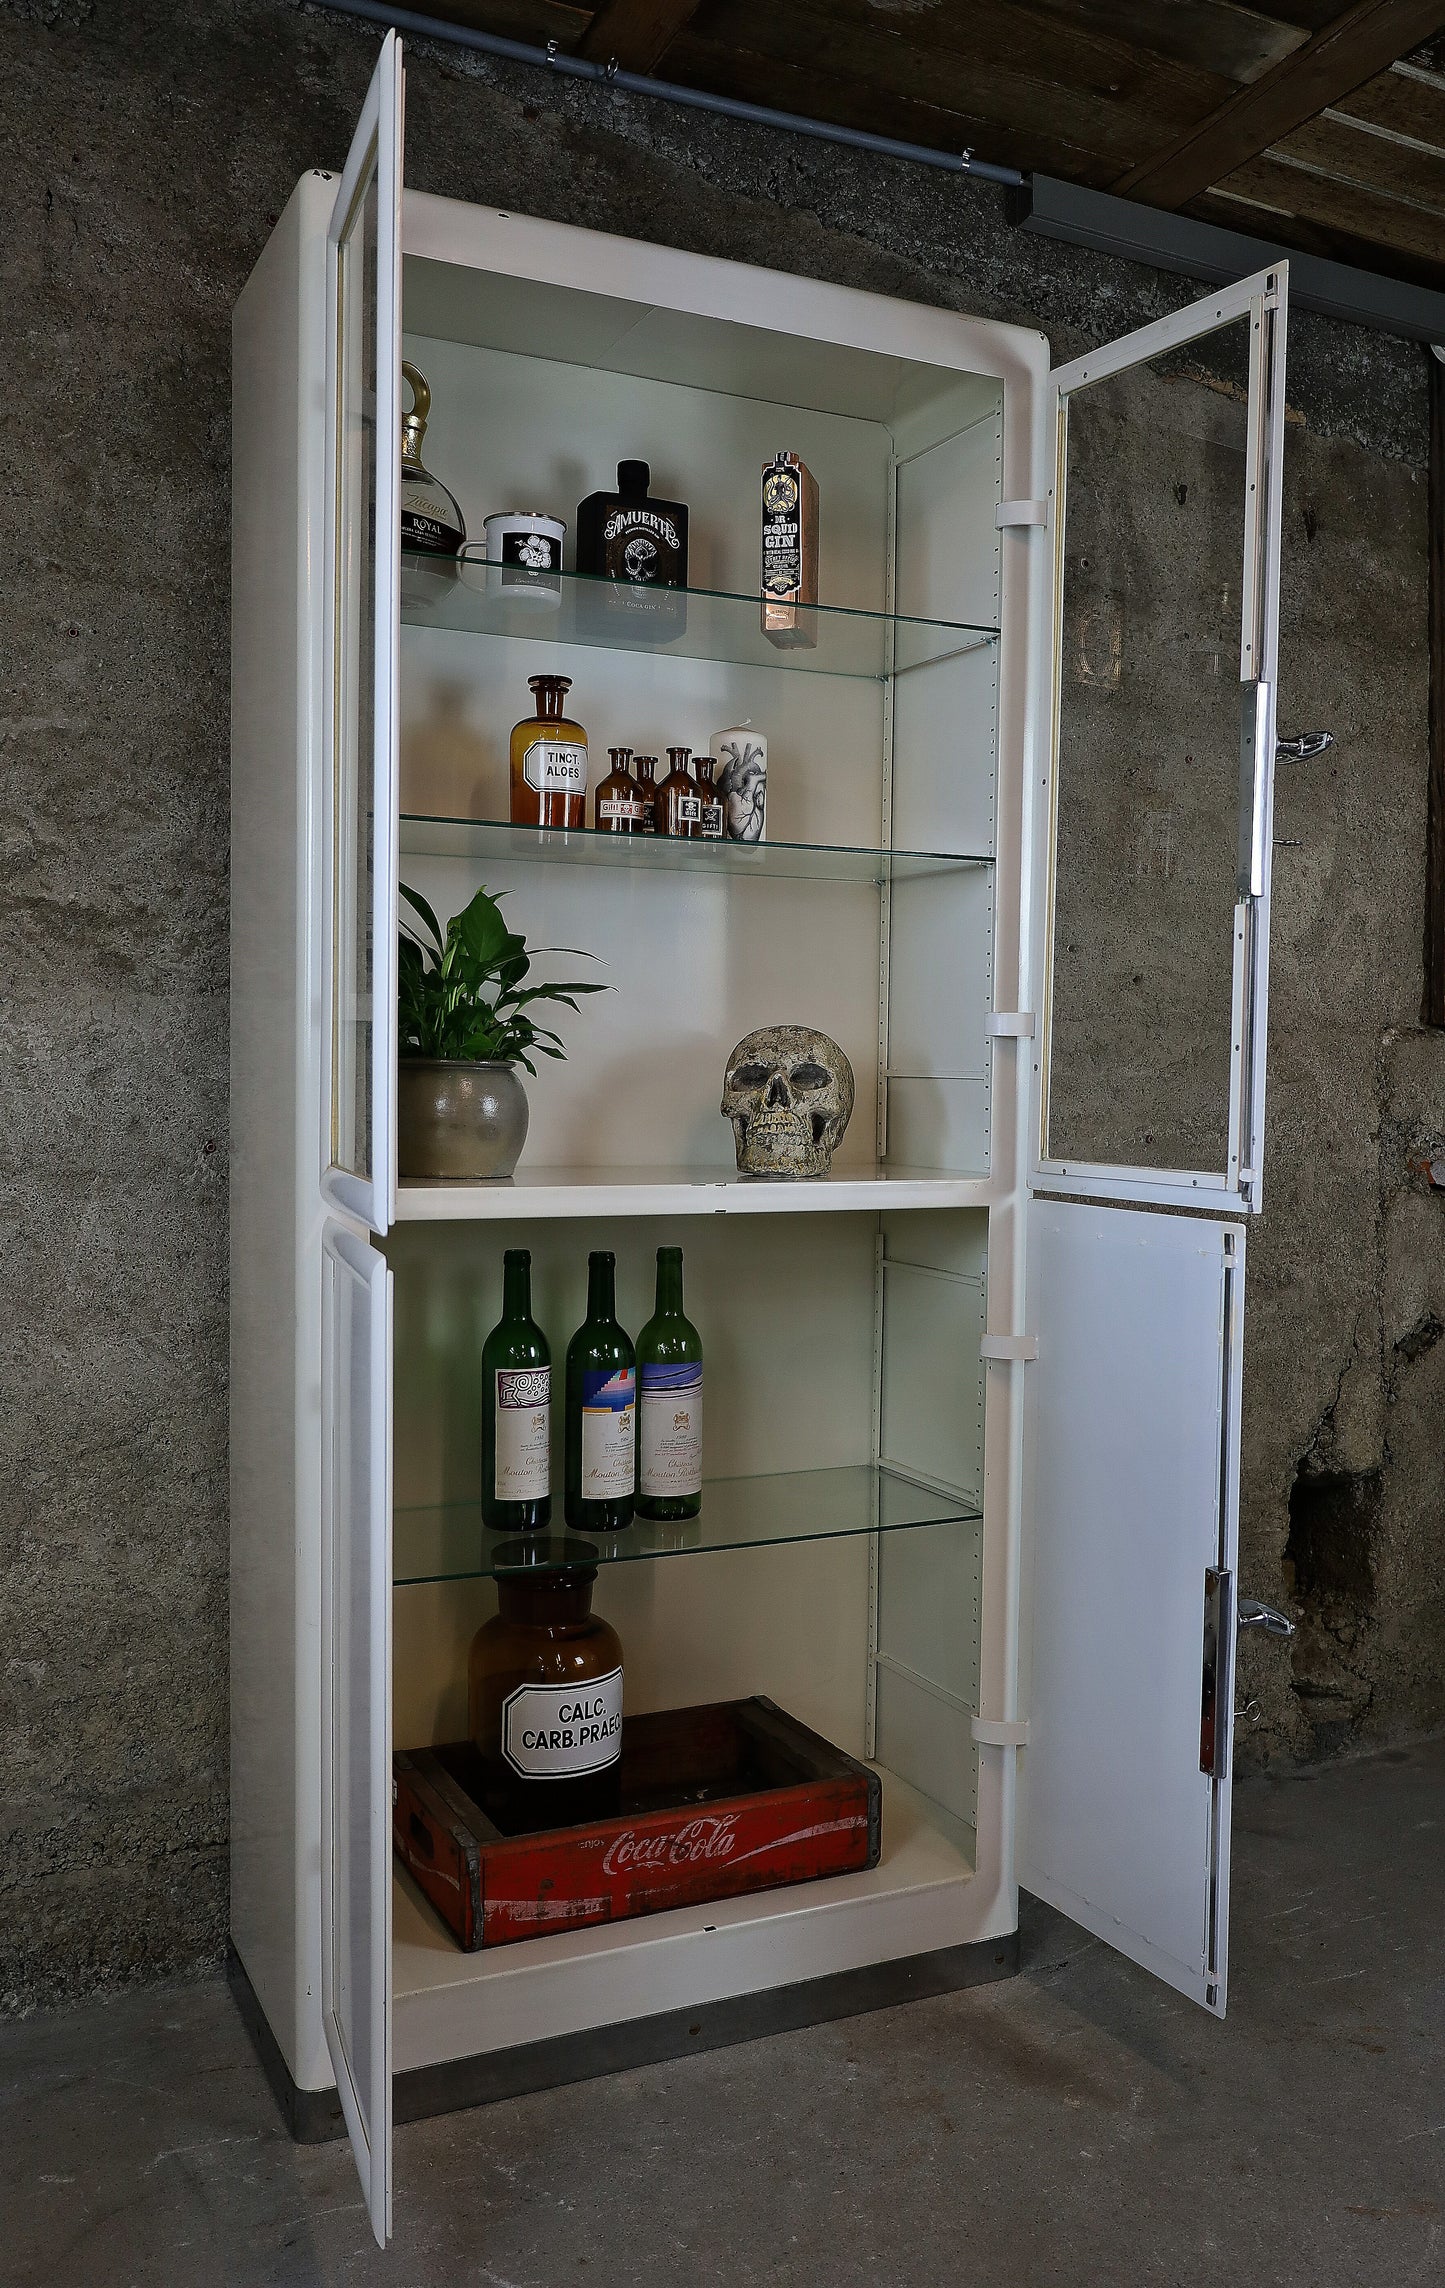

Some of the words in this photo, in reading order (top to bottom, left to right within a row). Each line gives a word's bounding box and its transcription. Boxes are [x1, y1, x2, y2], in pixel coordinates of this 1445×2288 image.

[404, 492, 448, 520] Zacapa
[774, 515, 786, 524] DR
[413, 518, 442, 535] ROYAL
[763, 523, 798, 536] SQUID
[765, 534, 796, 549] GIN
[547, 752, 580, 765] TINCT.
[546, 766, 580, 779] ALOES
[500, 1466, 535, 1477] Mouton
[584, 1468, 621, 1478] Mouton
[647, 1467, 677, 1478] Mouton
[559, 1698, 607, 1723] CALC.
[522, 1729, 578, 1750] CARB.
[602, 1812, 742, 1876] Coca-Cola
